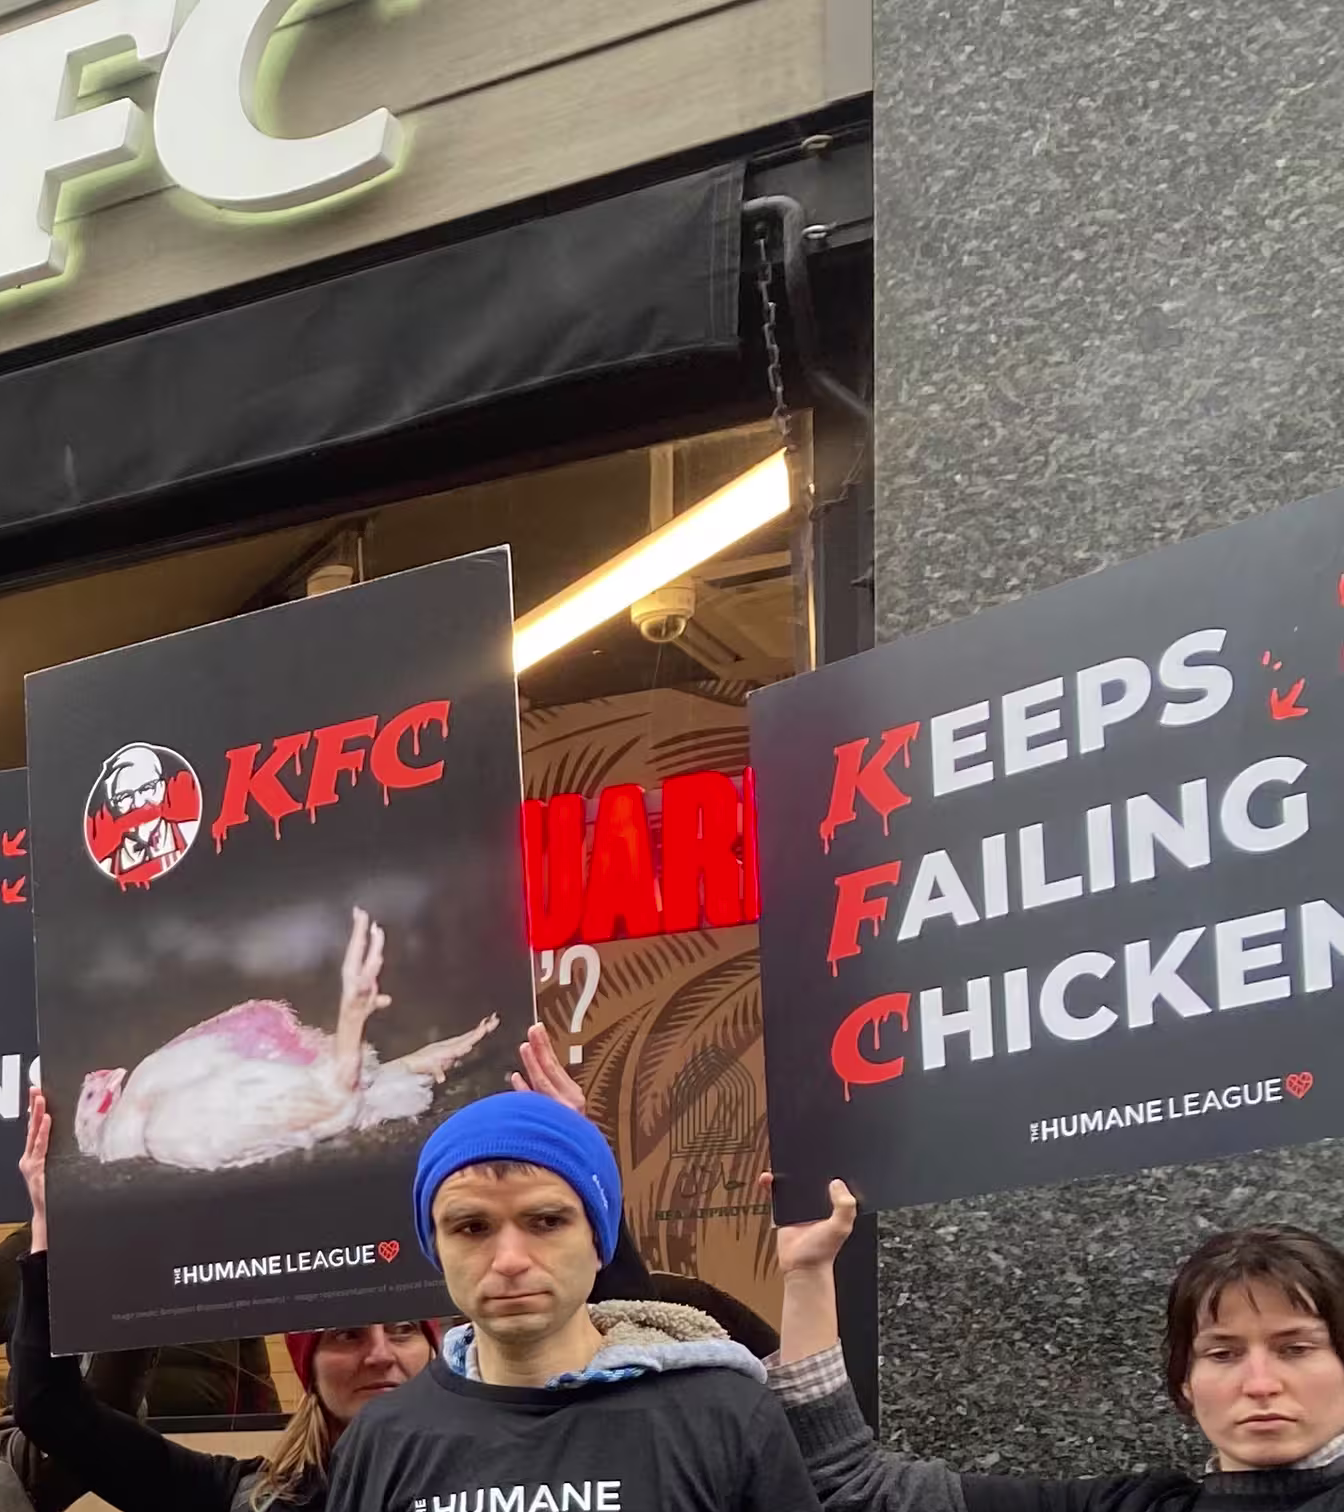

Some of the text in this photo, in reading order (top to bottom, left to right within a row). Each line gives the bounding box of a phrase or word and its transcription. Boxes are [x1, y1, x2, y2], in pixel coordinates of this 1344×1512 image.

[212, 700, 450, 846] KFC
[818, 627, 1235, 855] KEEPS
[523, 766, 760, 951] UAR
[825, 755, 1310, 978] FAILING
[1042, 1100, 1163, 1141] HUMANE
[1169, 1079, 1283, 1118] LEAGUE
[184, 1256, 281, 1284] HUMANE
[287, 1245, 375, 1272] LEAGUE
